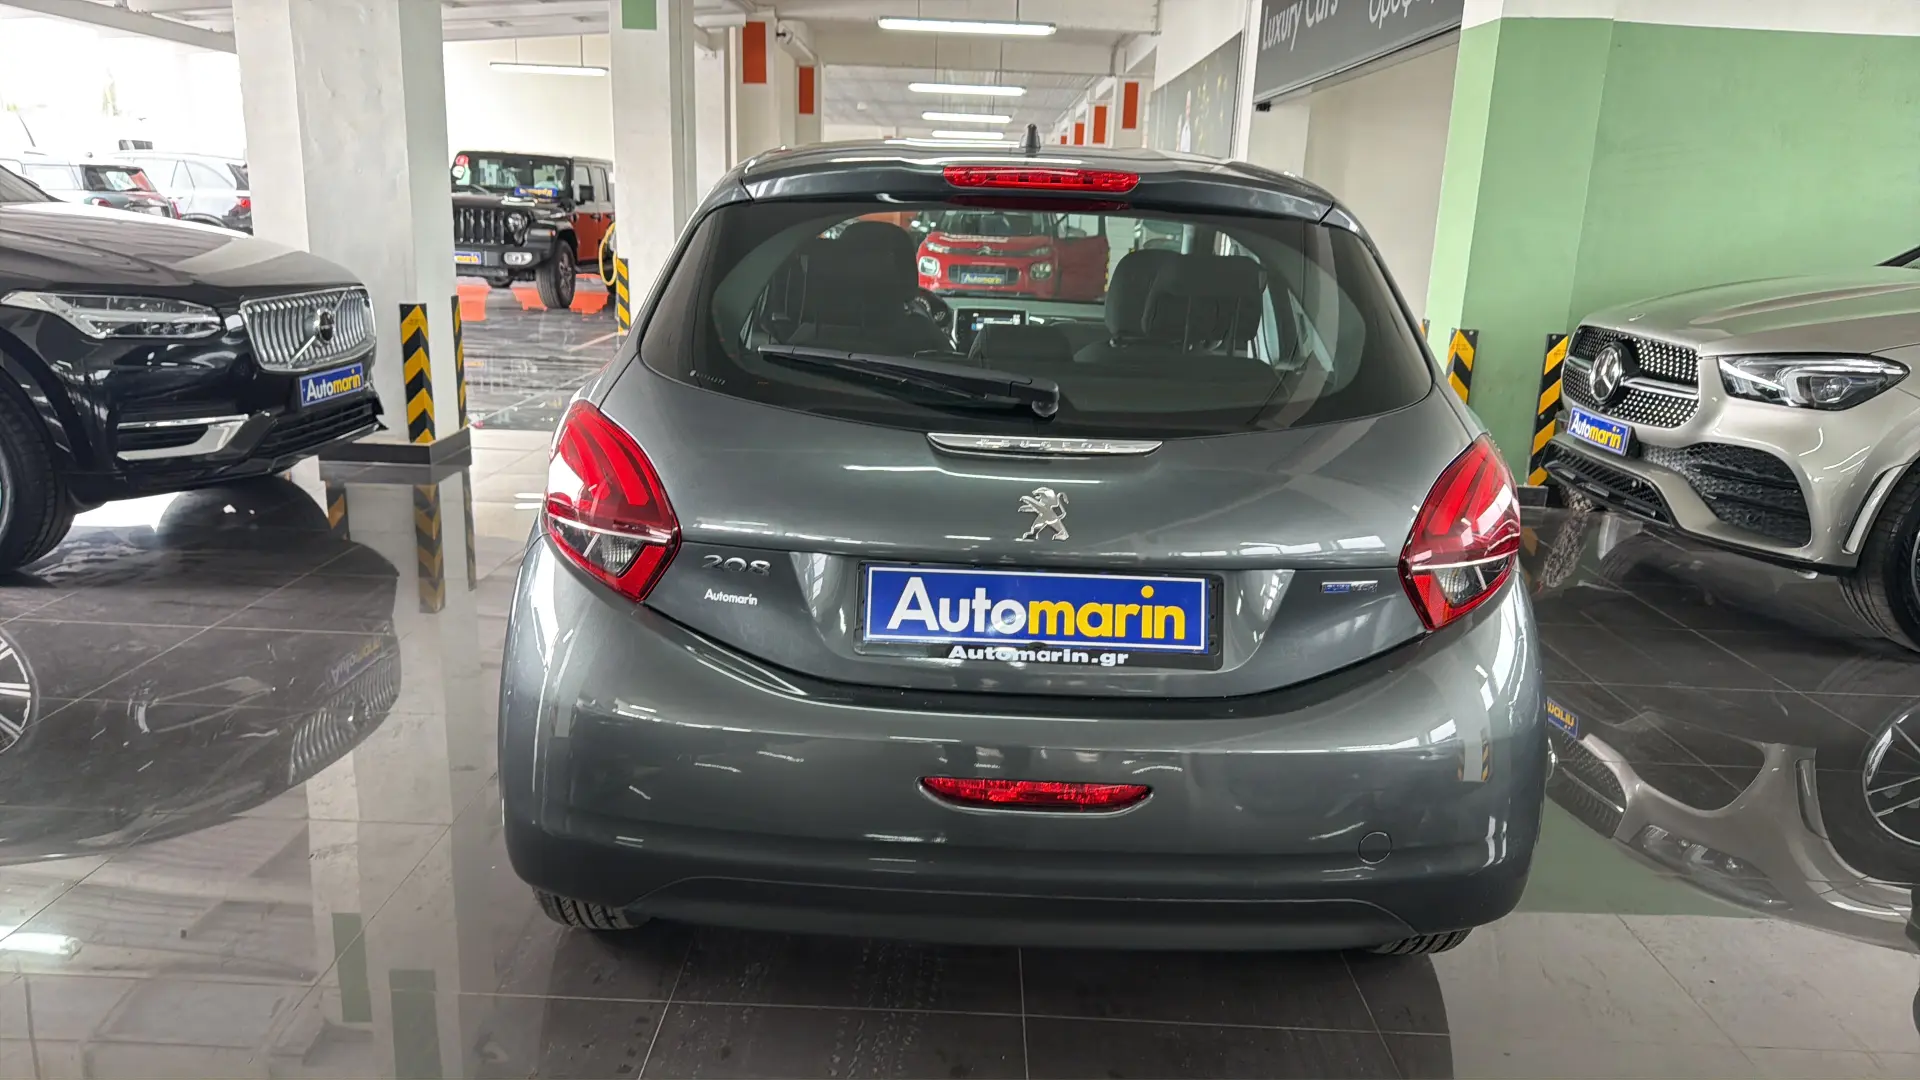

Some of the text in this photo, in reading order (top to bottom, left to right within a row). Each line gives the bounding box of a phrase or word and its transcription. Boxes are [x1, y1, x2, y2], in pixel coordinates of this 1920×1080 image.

[1262, 0, 1303, 52] Luxury
[306, 368, 361, 401] Automarin
[1571, 412, 1621, 449] Automarin
[702, 554, 771, 576] 208
[703, 588, 758, 606] Automarin
[886, 576, 1186, 640] Automarin
[949, 645, 1129, 667] Automarin.gr
